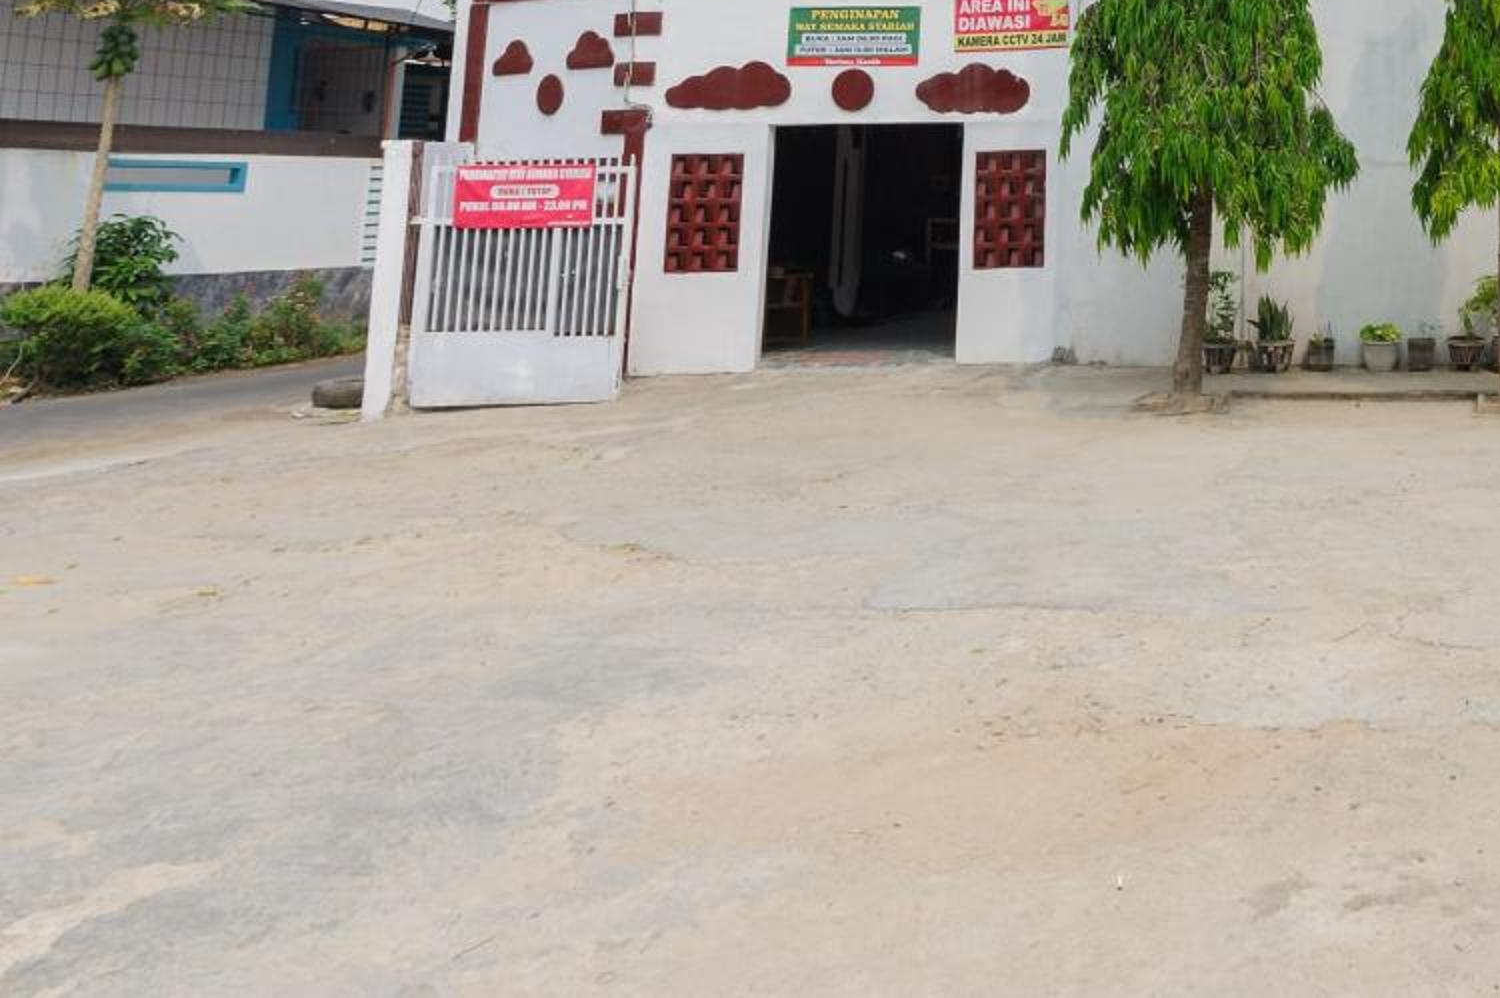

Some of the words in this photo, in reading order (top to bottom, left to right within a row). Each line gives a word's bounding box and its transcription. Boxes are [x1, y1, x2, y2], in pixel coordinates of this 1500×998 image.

[959, 0, 1002, 14] AREA
[811, 9, 900, 20] PENGINAPAN
[958, 15, 1031, 31] DIAWASI
[957, 35, 1001, 47] KAMERA
[1002, 34, 1029, 46] CCTV
[1031, 34, 1043, 45] 24
[1045, 33, 1067, 44] JAM
